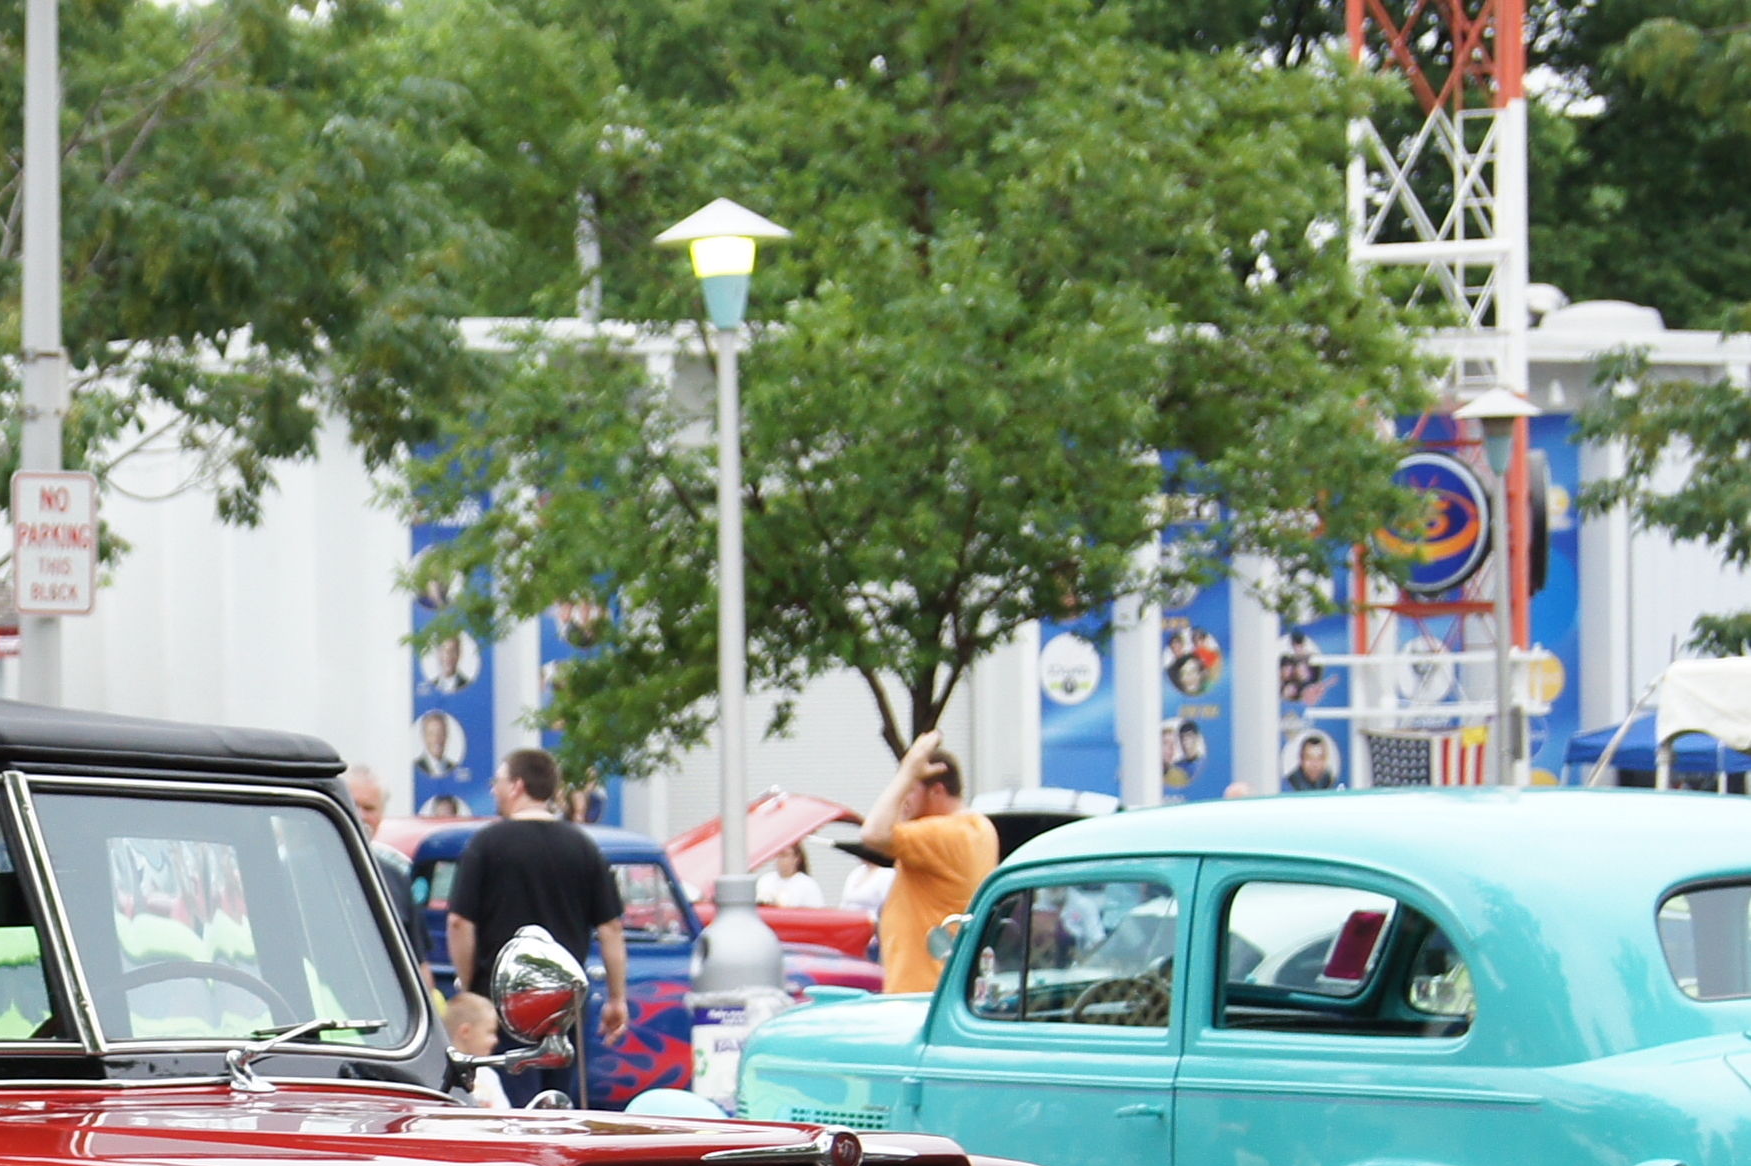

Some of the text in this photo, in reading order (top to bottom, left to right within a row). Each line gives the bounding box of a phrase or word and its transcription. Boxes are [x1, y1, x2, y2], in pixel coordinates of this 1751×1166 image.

[39, 486, 70, 512] NO
[17, 522, 92, 548] PARKING
[39, 556, 72, 575] THIS
[30, 581, 78, 601] BLOCK
